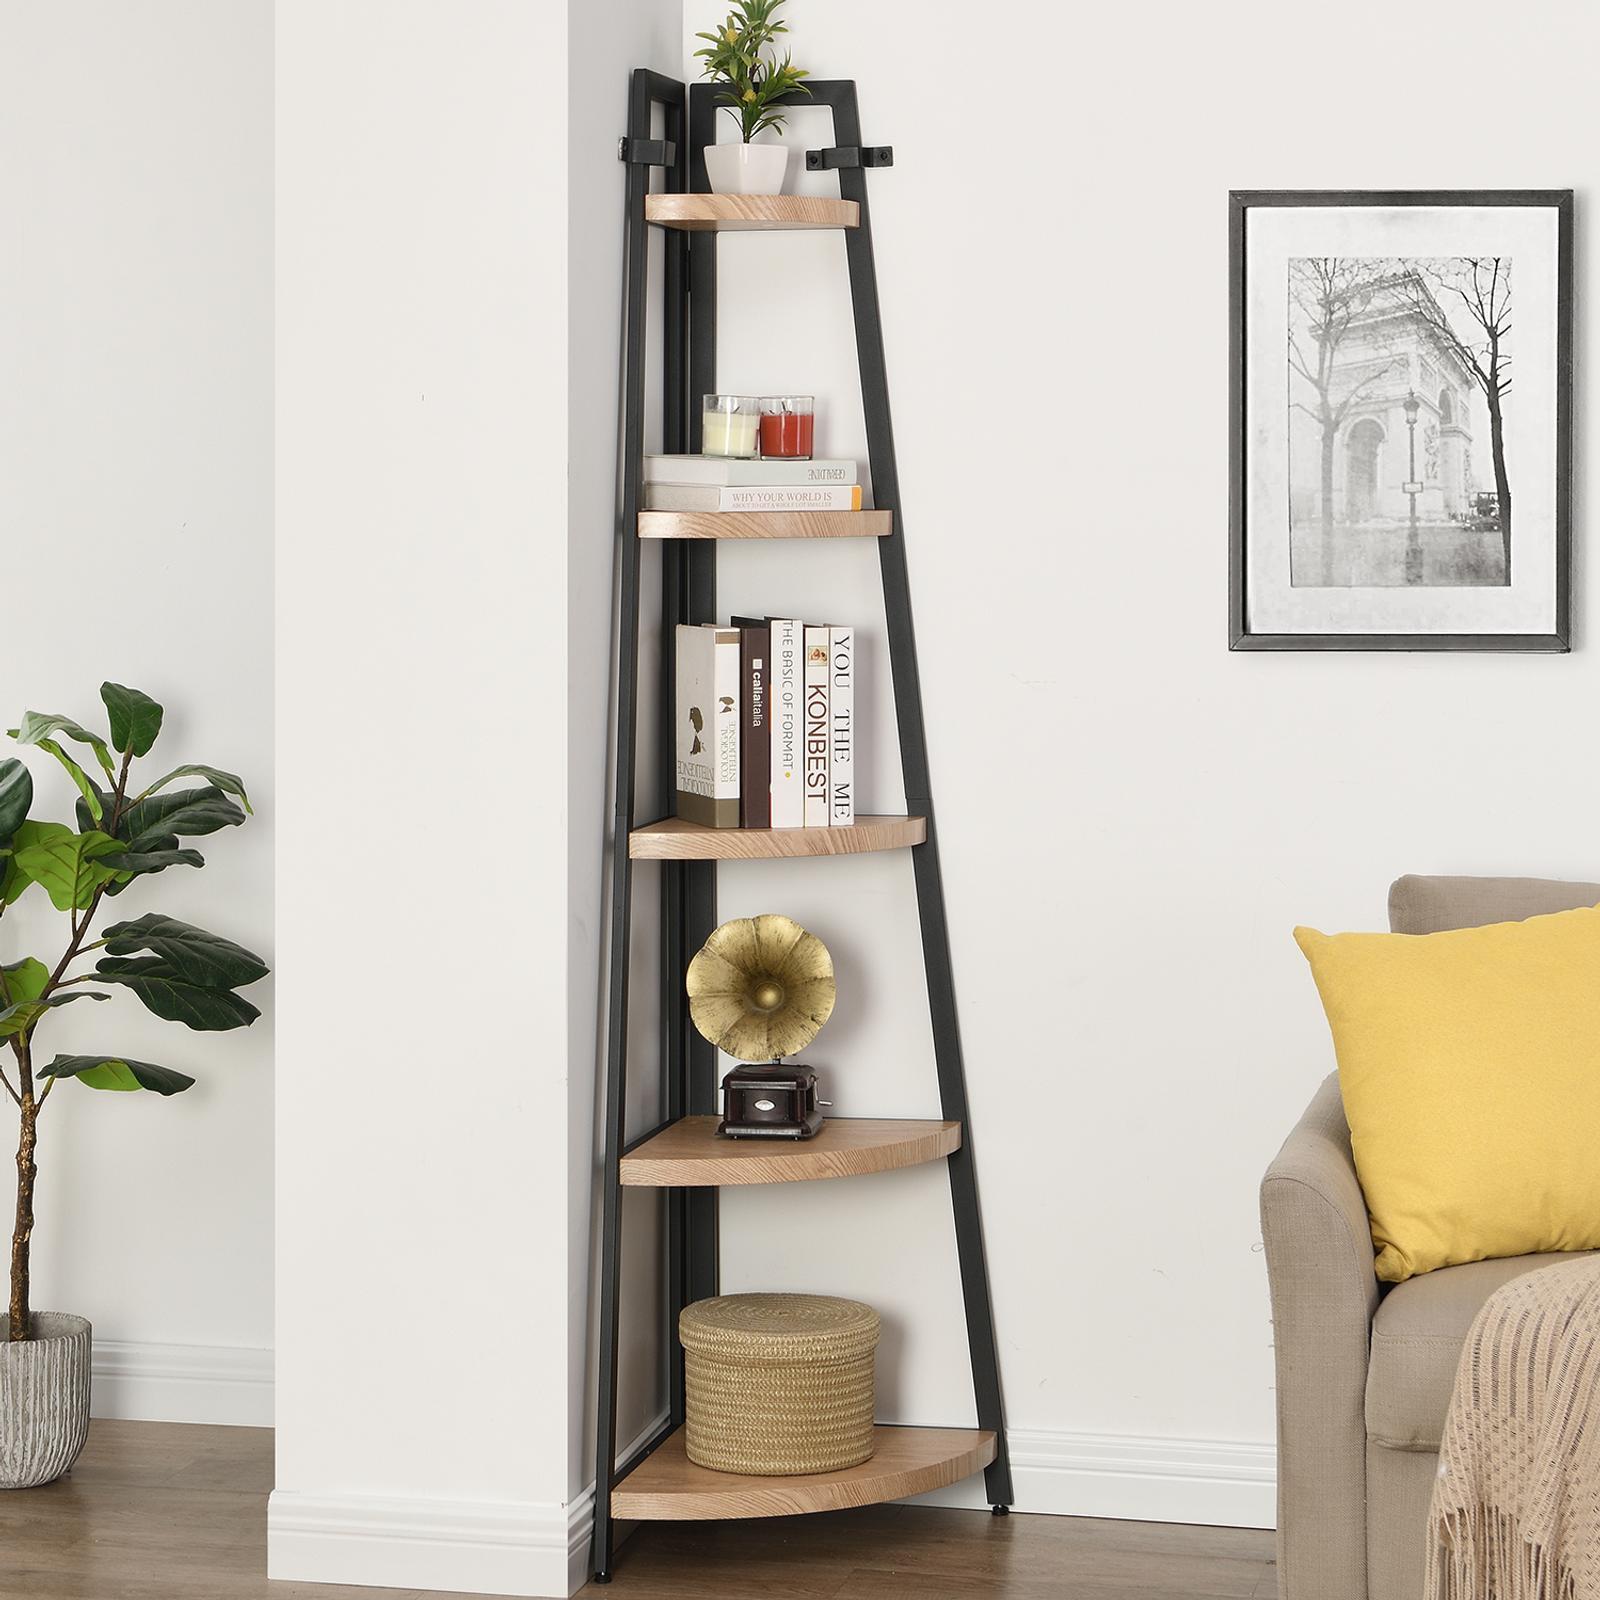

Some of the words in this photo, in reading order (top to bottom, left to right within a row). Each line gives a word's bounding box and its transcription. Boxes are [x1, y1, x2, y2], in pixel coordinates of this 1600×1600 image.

[732, 493, 755, 502] WHY
[757, 492, 784, 502] YOUR
[787, 492, 822, 501] WORLD
[824, 491, 833, 501] IS
[782, 621, 794, 646] THE
[782, 650, 794, 688] BASIC
[834, 635, 850, 688] YOU
[783, 692, 794, 709] OF
[783, 713, 794, 770] FORMAT
[807, 684, 827, 804] KONBEST
[834, 709, 850, 763] THE
[834, 783, 850, 819] ME
